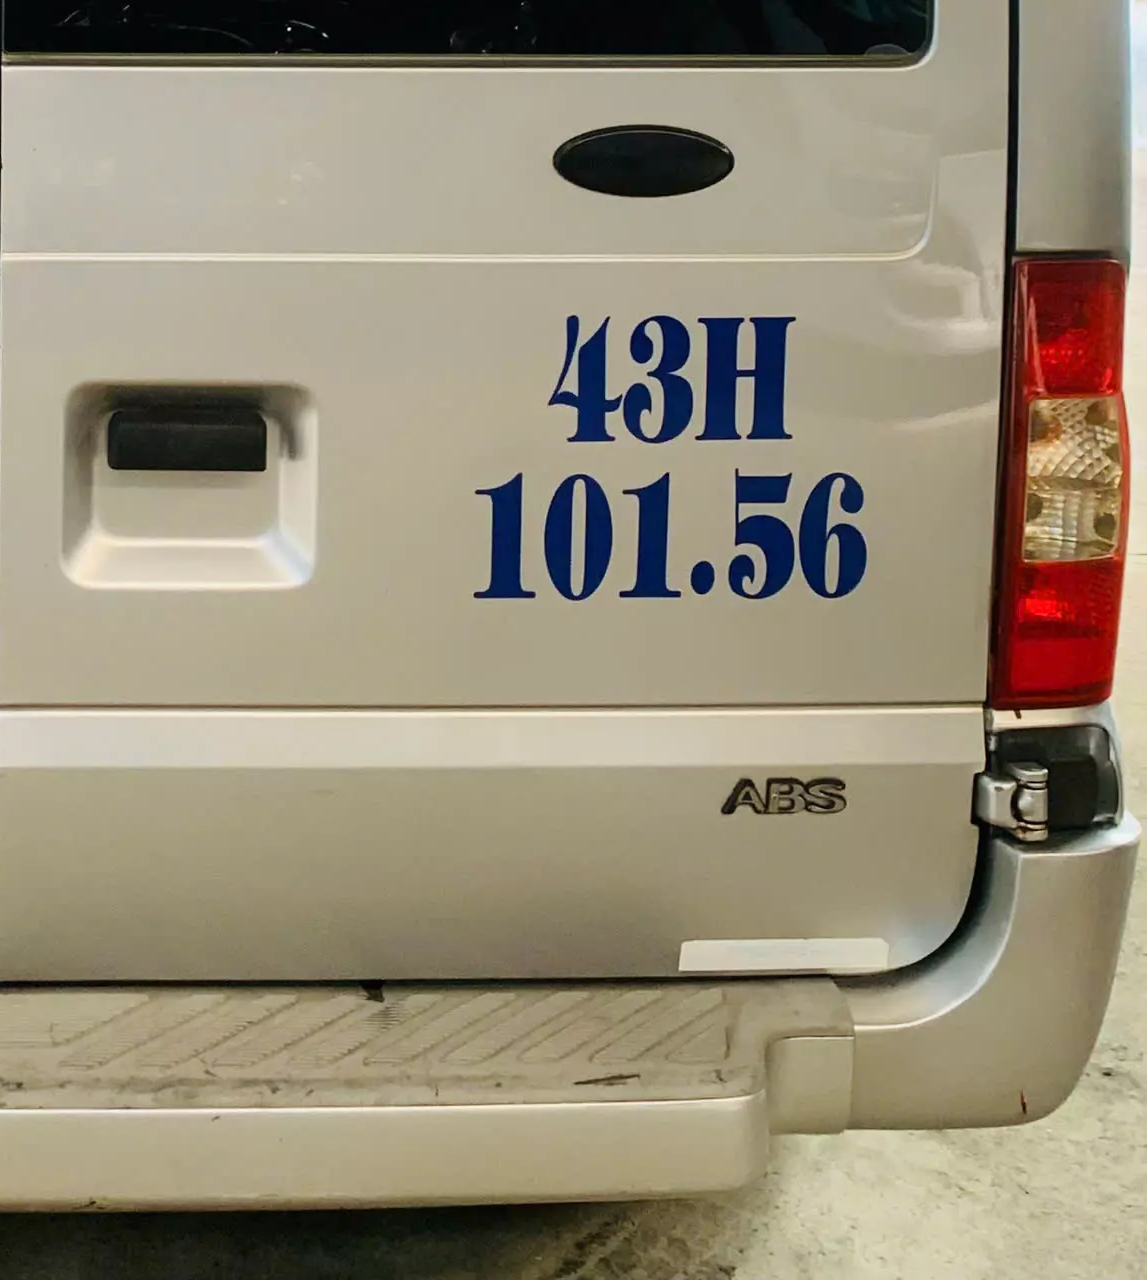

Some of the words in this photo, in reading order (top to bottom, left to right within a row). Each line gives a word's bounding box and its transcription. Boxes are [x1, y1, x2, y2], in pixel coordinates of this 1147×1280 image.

[547, 314, 796, 444] 43H
[473, 468, 867, 601] 101.56
[721, 777, 847, 814] ABS
